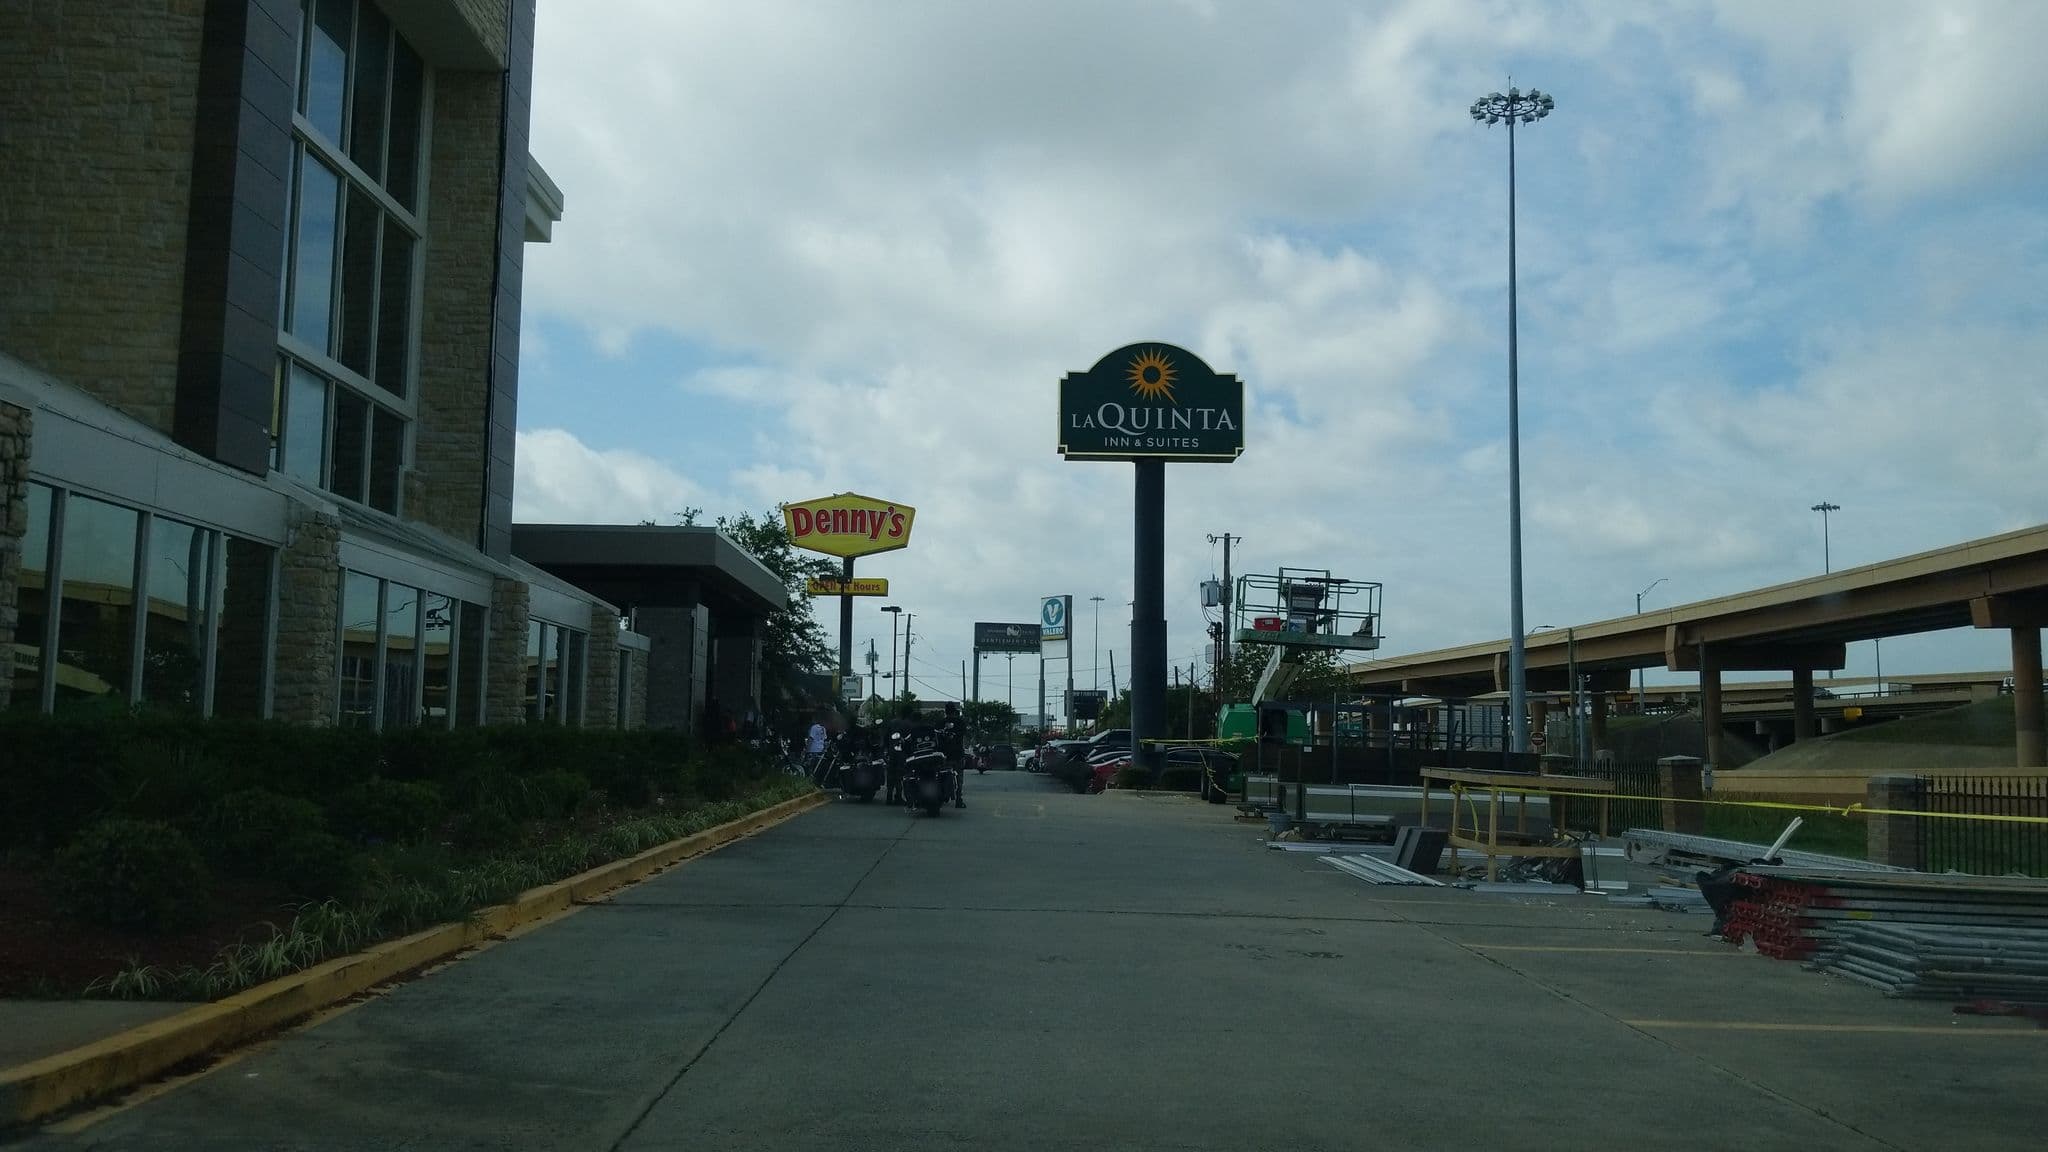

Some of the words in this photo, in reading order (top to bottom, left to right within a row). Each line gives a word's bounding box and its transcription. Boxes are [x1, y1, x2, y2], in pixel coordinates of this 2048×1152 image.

[1072, 413, 1096, 428] LA
[1097, 402, 1237, 436] QUINTA
[1104, 437, 1130, 447] INN
[1135, 439, 1142, 447] &
[1146, 437, 1199, 448] SUITES
[790, 505, 906, 541] Denny's
[1042, 627, 1064, 636] VALERO
